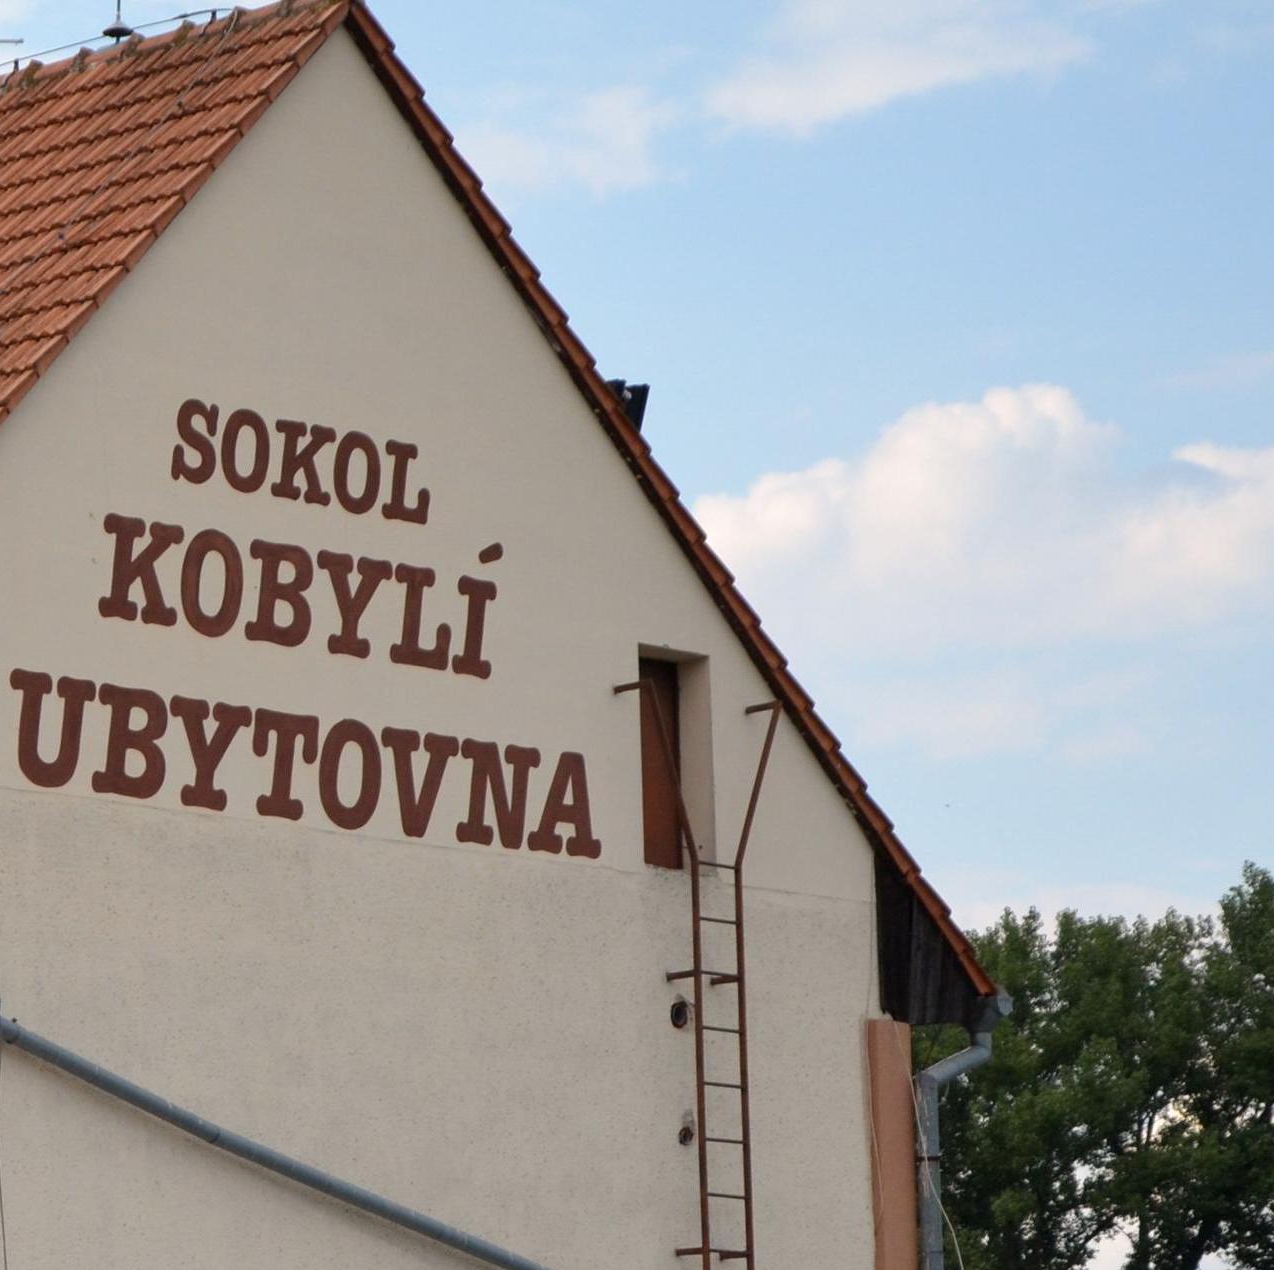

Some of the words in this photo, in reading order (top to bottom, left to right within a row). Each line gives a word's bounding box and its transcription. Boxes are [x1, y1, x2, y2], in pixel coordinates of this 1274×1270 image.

[170, 398, 431, 526] SOKOL
[97, 511, 504, 680] KOBYLÍ
[9, 667, 602, 860] UBYTOVNA
